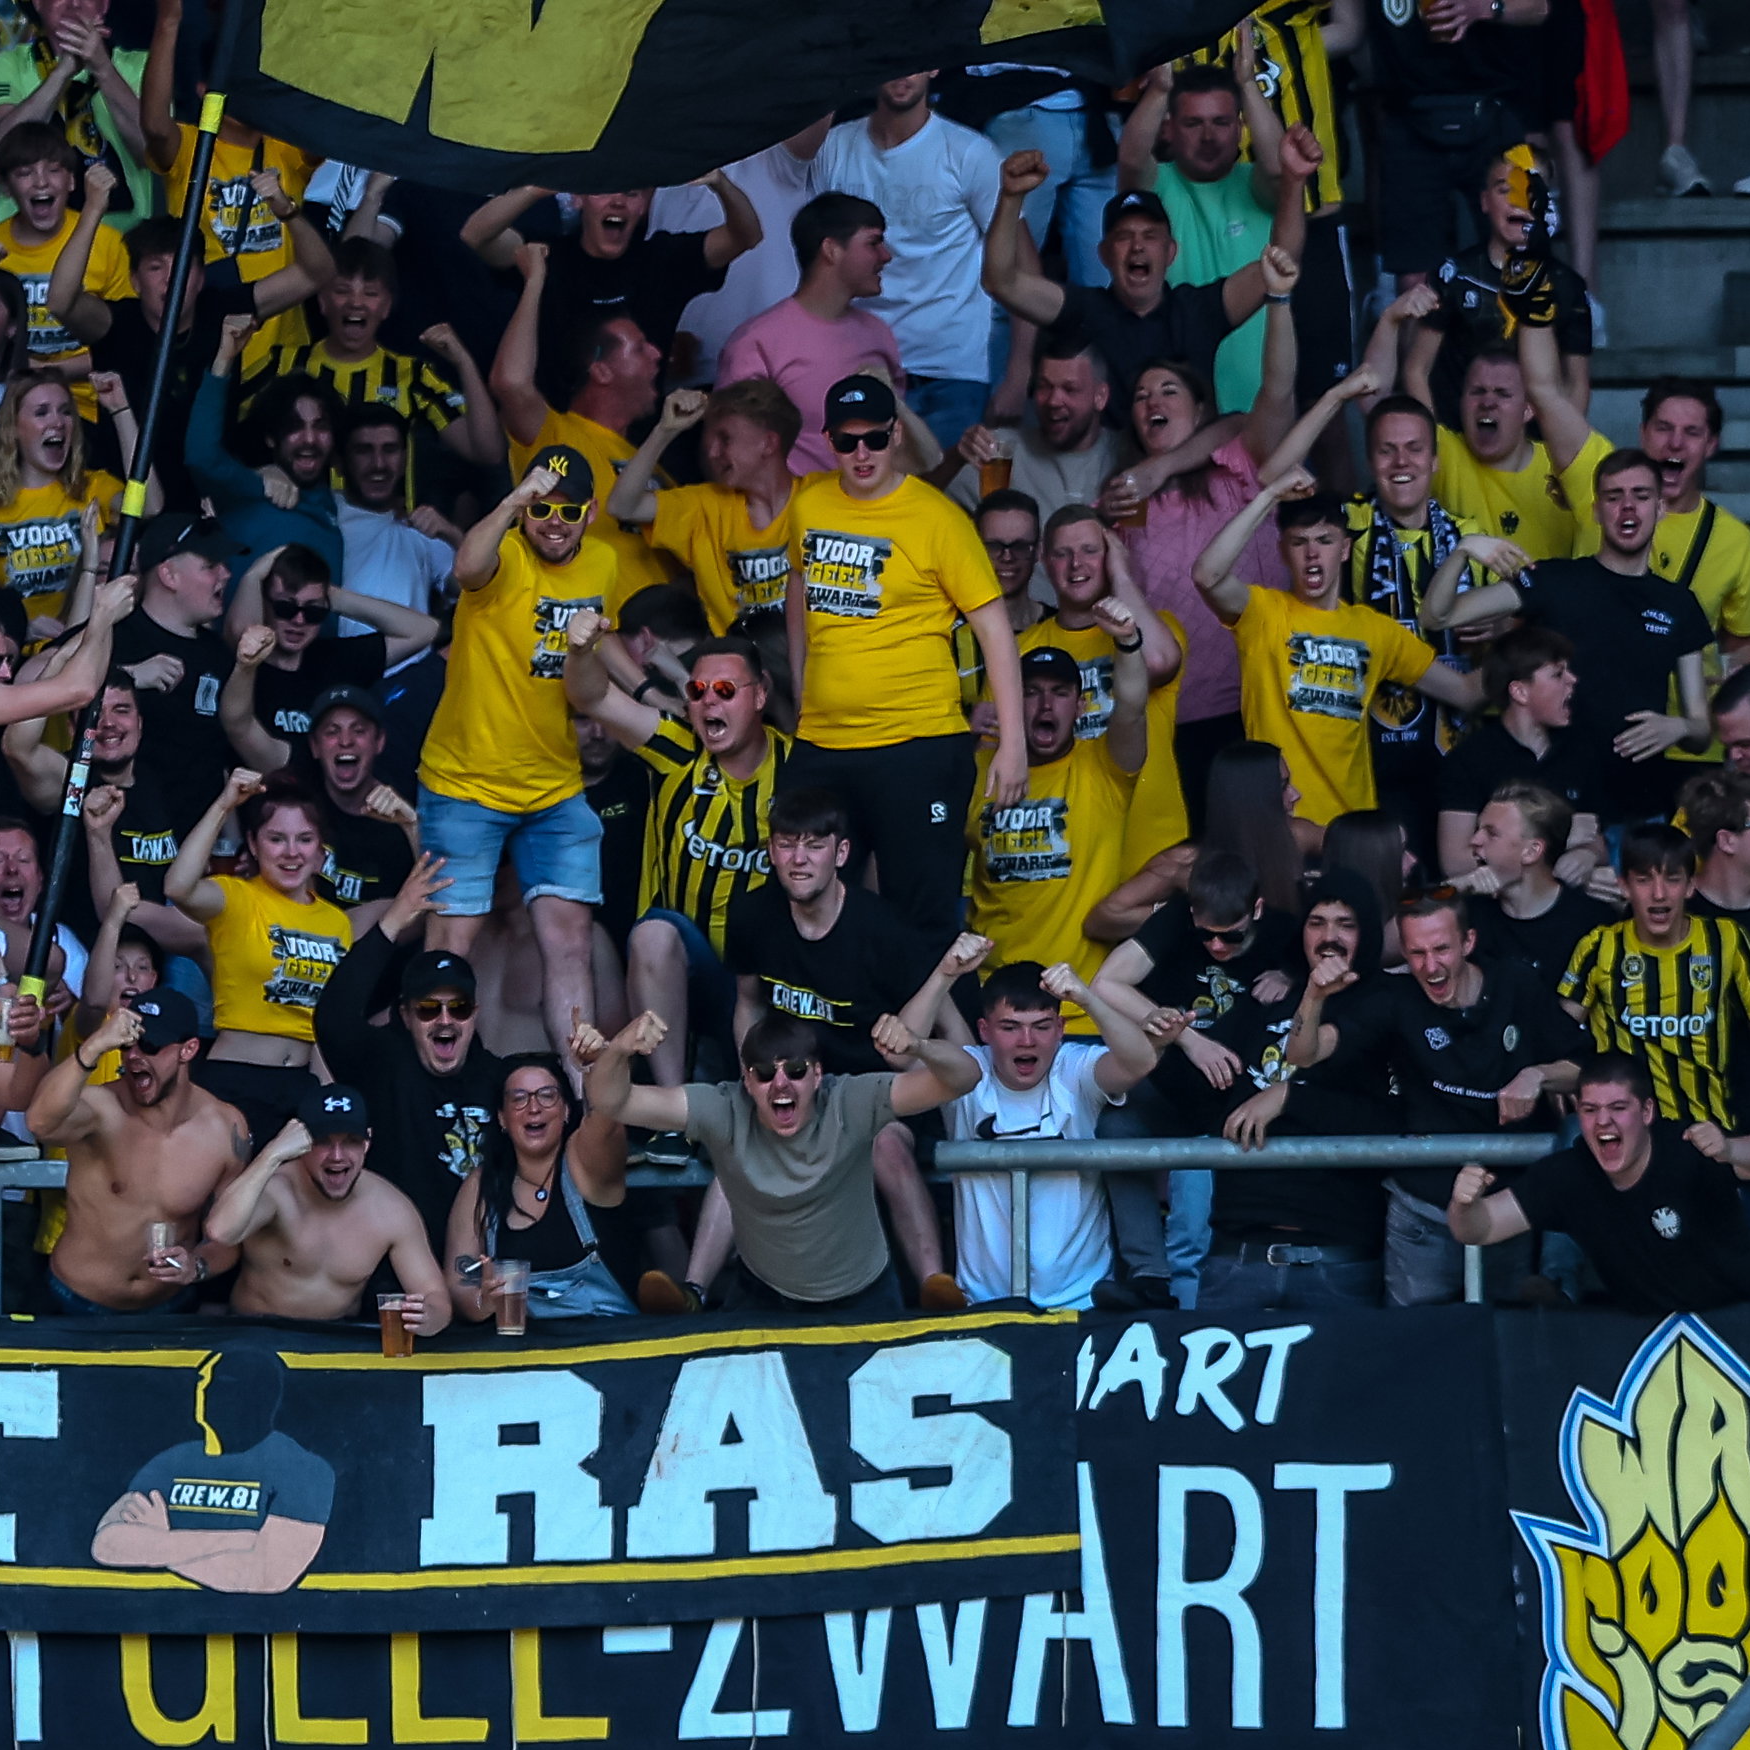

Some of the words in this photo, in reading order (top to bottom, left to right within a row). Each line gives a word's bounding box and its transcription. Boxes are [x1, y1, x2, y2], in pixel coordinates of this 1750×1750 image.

[815, 538, 875, 567] VOOR
[995, 807, 1051, 830] VOOR
[170, 1484, 260, 1511] CREW.81
